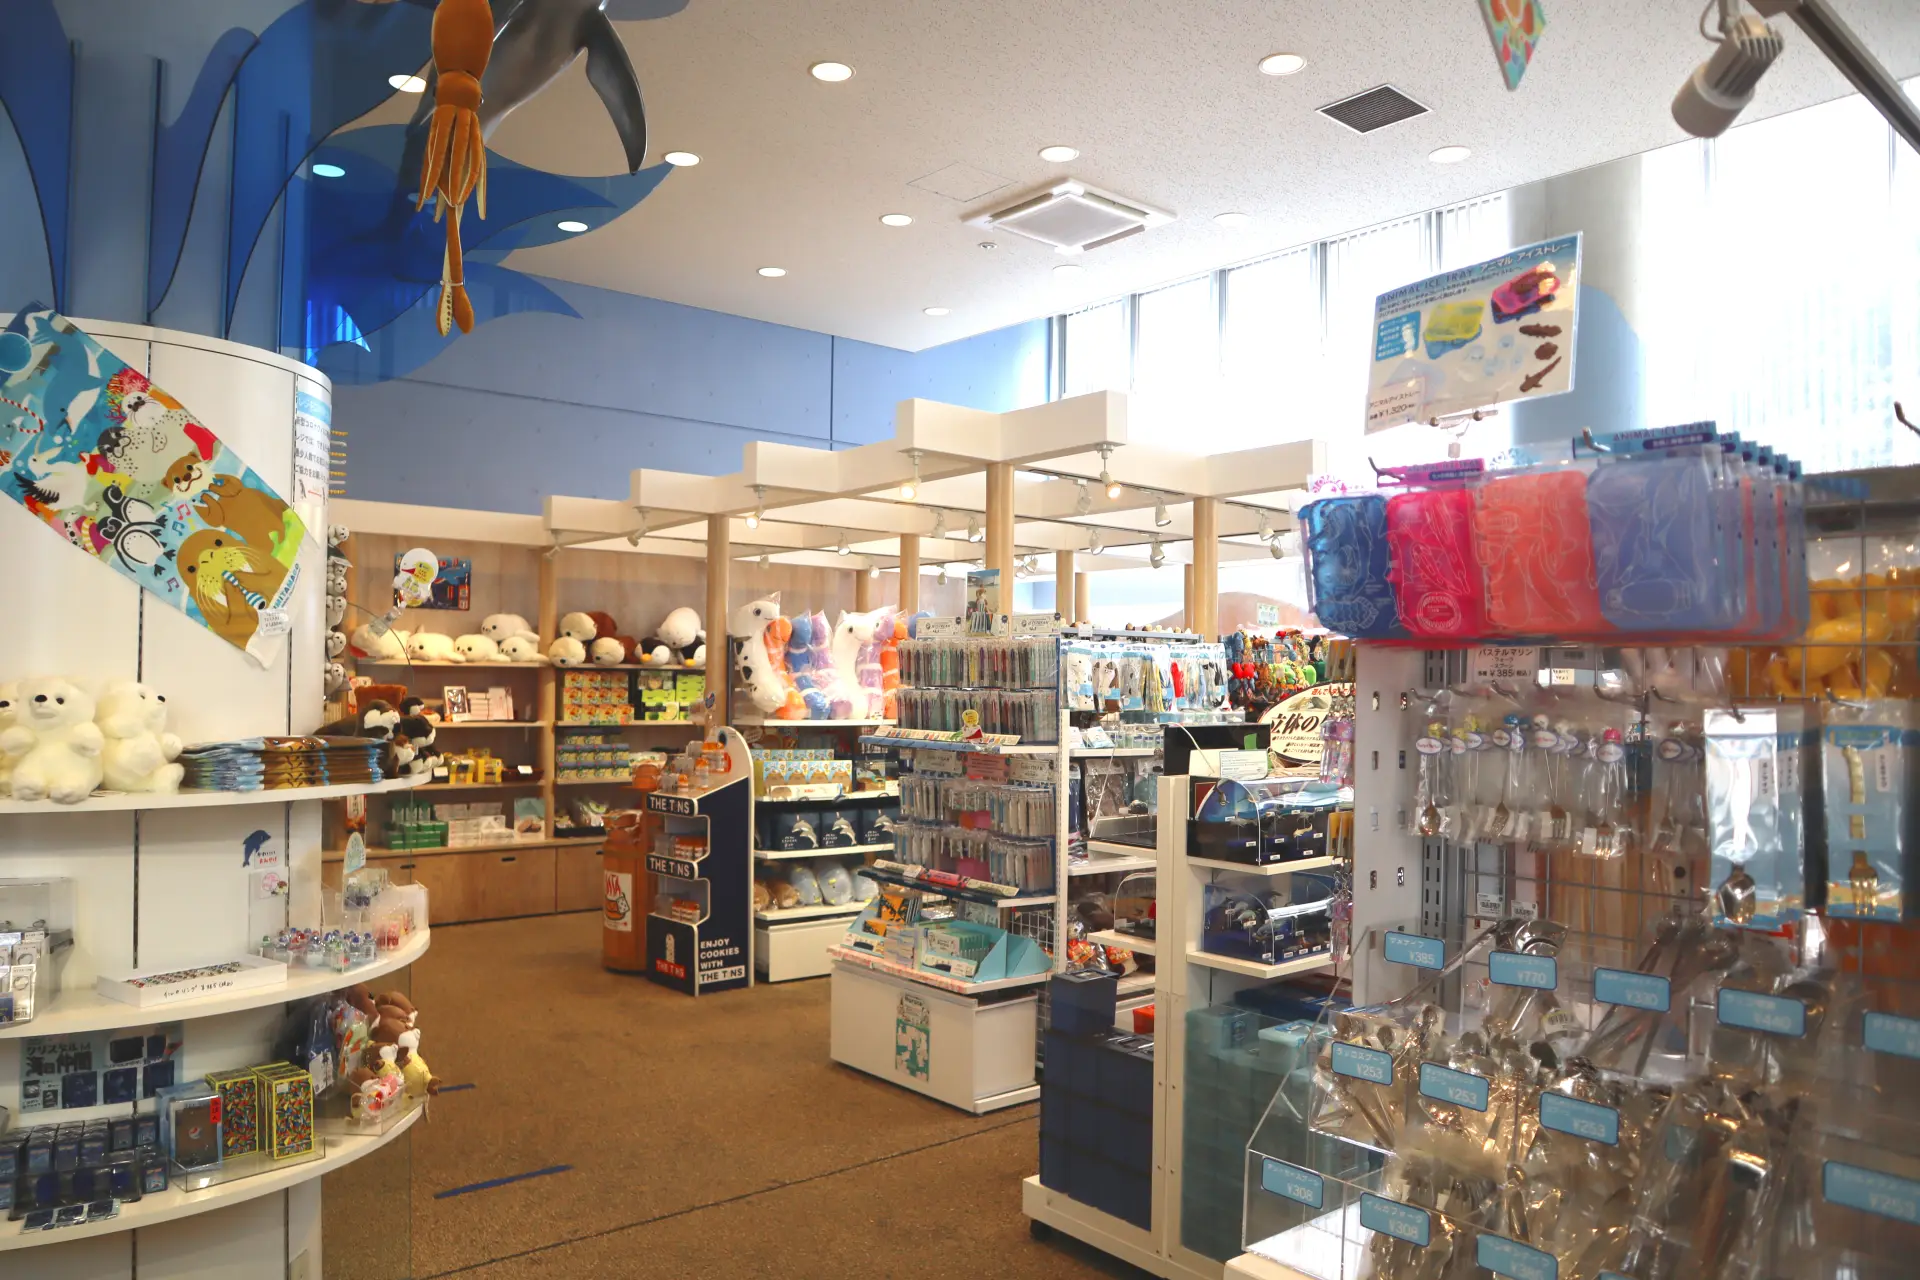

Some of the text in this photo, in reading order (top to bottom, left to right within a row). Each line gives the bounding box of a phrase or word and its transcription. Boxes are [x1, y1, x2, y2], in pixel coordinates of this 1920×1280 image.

[1480, 241, 1572, 272] アニマル アイストレー
[1380, 268, 1473, 304] ANIMAL ICE TRAY
[1478, 648, 1533, 657] パステルマリン
[1271, 713, 1329, 735] 立体の
[649, 796, 690, 814] THE TNS
[649, 857, 690, 877] THE TNS
[700, 938, 730, 949] ENJOY
[700, 947, 740, 960] COOKIES
[1408, 951, 1435, 965] ¥385
[656, 960, 669, 973] THE
[700, 959, 724, 970] WITH
[700, 968, 743, 982] THE TNS
[1516, 970, 1547, 985] ¥770
[26, 1051, 92, 1077] 海の仲間
[1356, 1063, 1384, 1080] ¥253
[1448, 1087, 1477, 1105] ¥253
[1287, 1182, 1314, 1202] ¥308
[1388, 1219, 1419, 1239] ¥308
